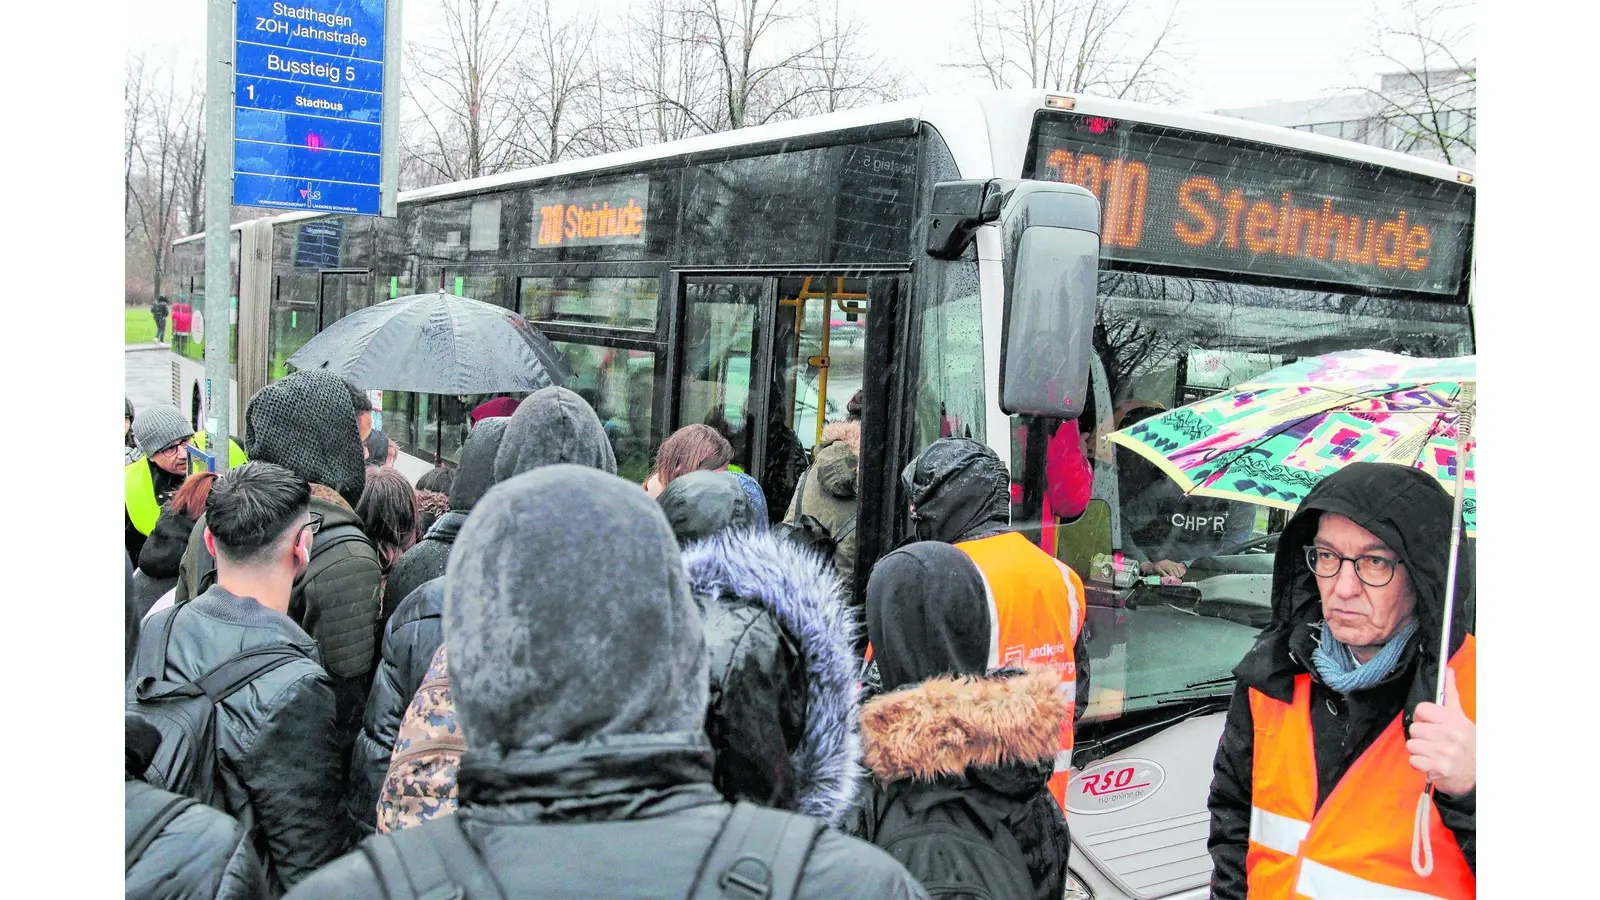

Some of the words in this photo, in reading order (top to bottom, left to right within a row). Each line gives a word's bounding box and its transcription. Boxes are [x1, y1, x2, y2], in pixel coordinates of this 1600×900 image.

[273, 2, 352, 27] Stadthagen
[255, 17, 289, 35] ZOH
[292, 23, 368, 47] Jahnstraße
[267, 54, 340, 82] Bussteig
[345, 67, 356, 81] 5
[247, 84, 254, 100] 1
[295, 96, 344, 111] Stadtbus
[565, 198, 644, 240] Steinhude
[1174, 175, 1431, 273] Steinhude
[1081, 767, 1135, 796] RSO
[1098, 789, 1145, 804] rso-online.de
